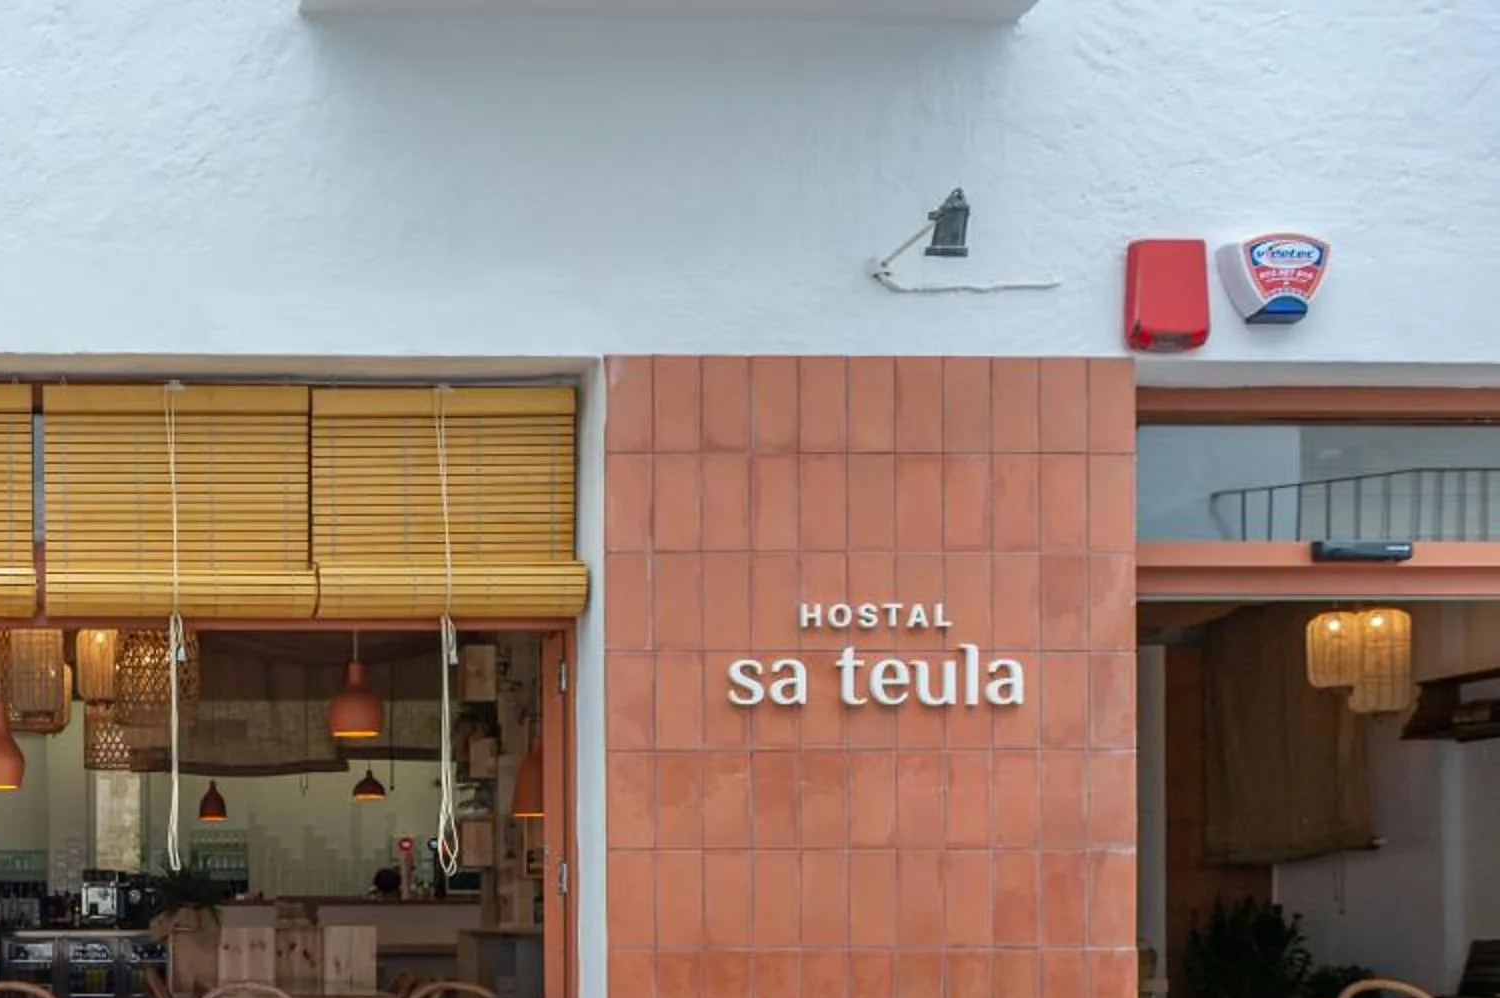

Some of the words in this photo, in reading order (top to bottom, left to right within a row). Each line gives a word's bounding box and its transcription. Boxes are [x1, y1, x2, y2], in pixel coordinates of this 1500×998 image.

[800, 602, 954, 629] HOSTAL
[727, 656, 808, 707] sa
[835, 642, 1025, 707] teula
